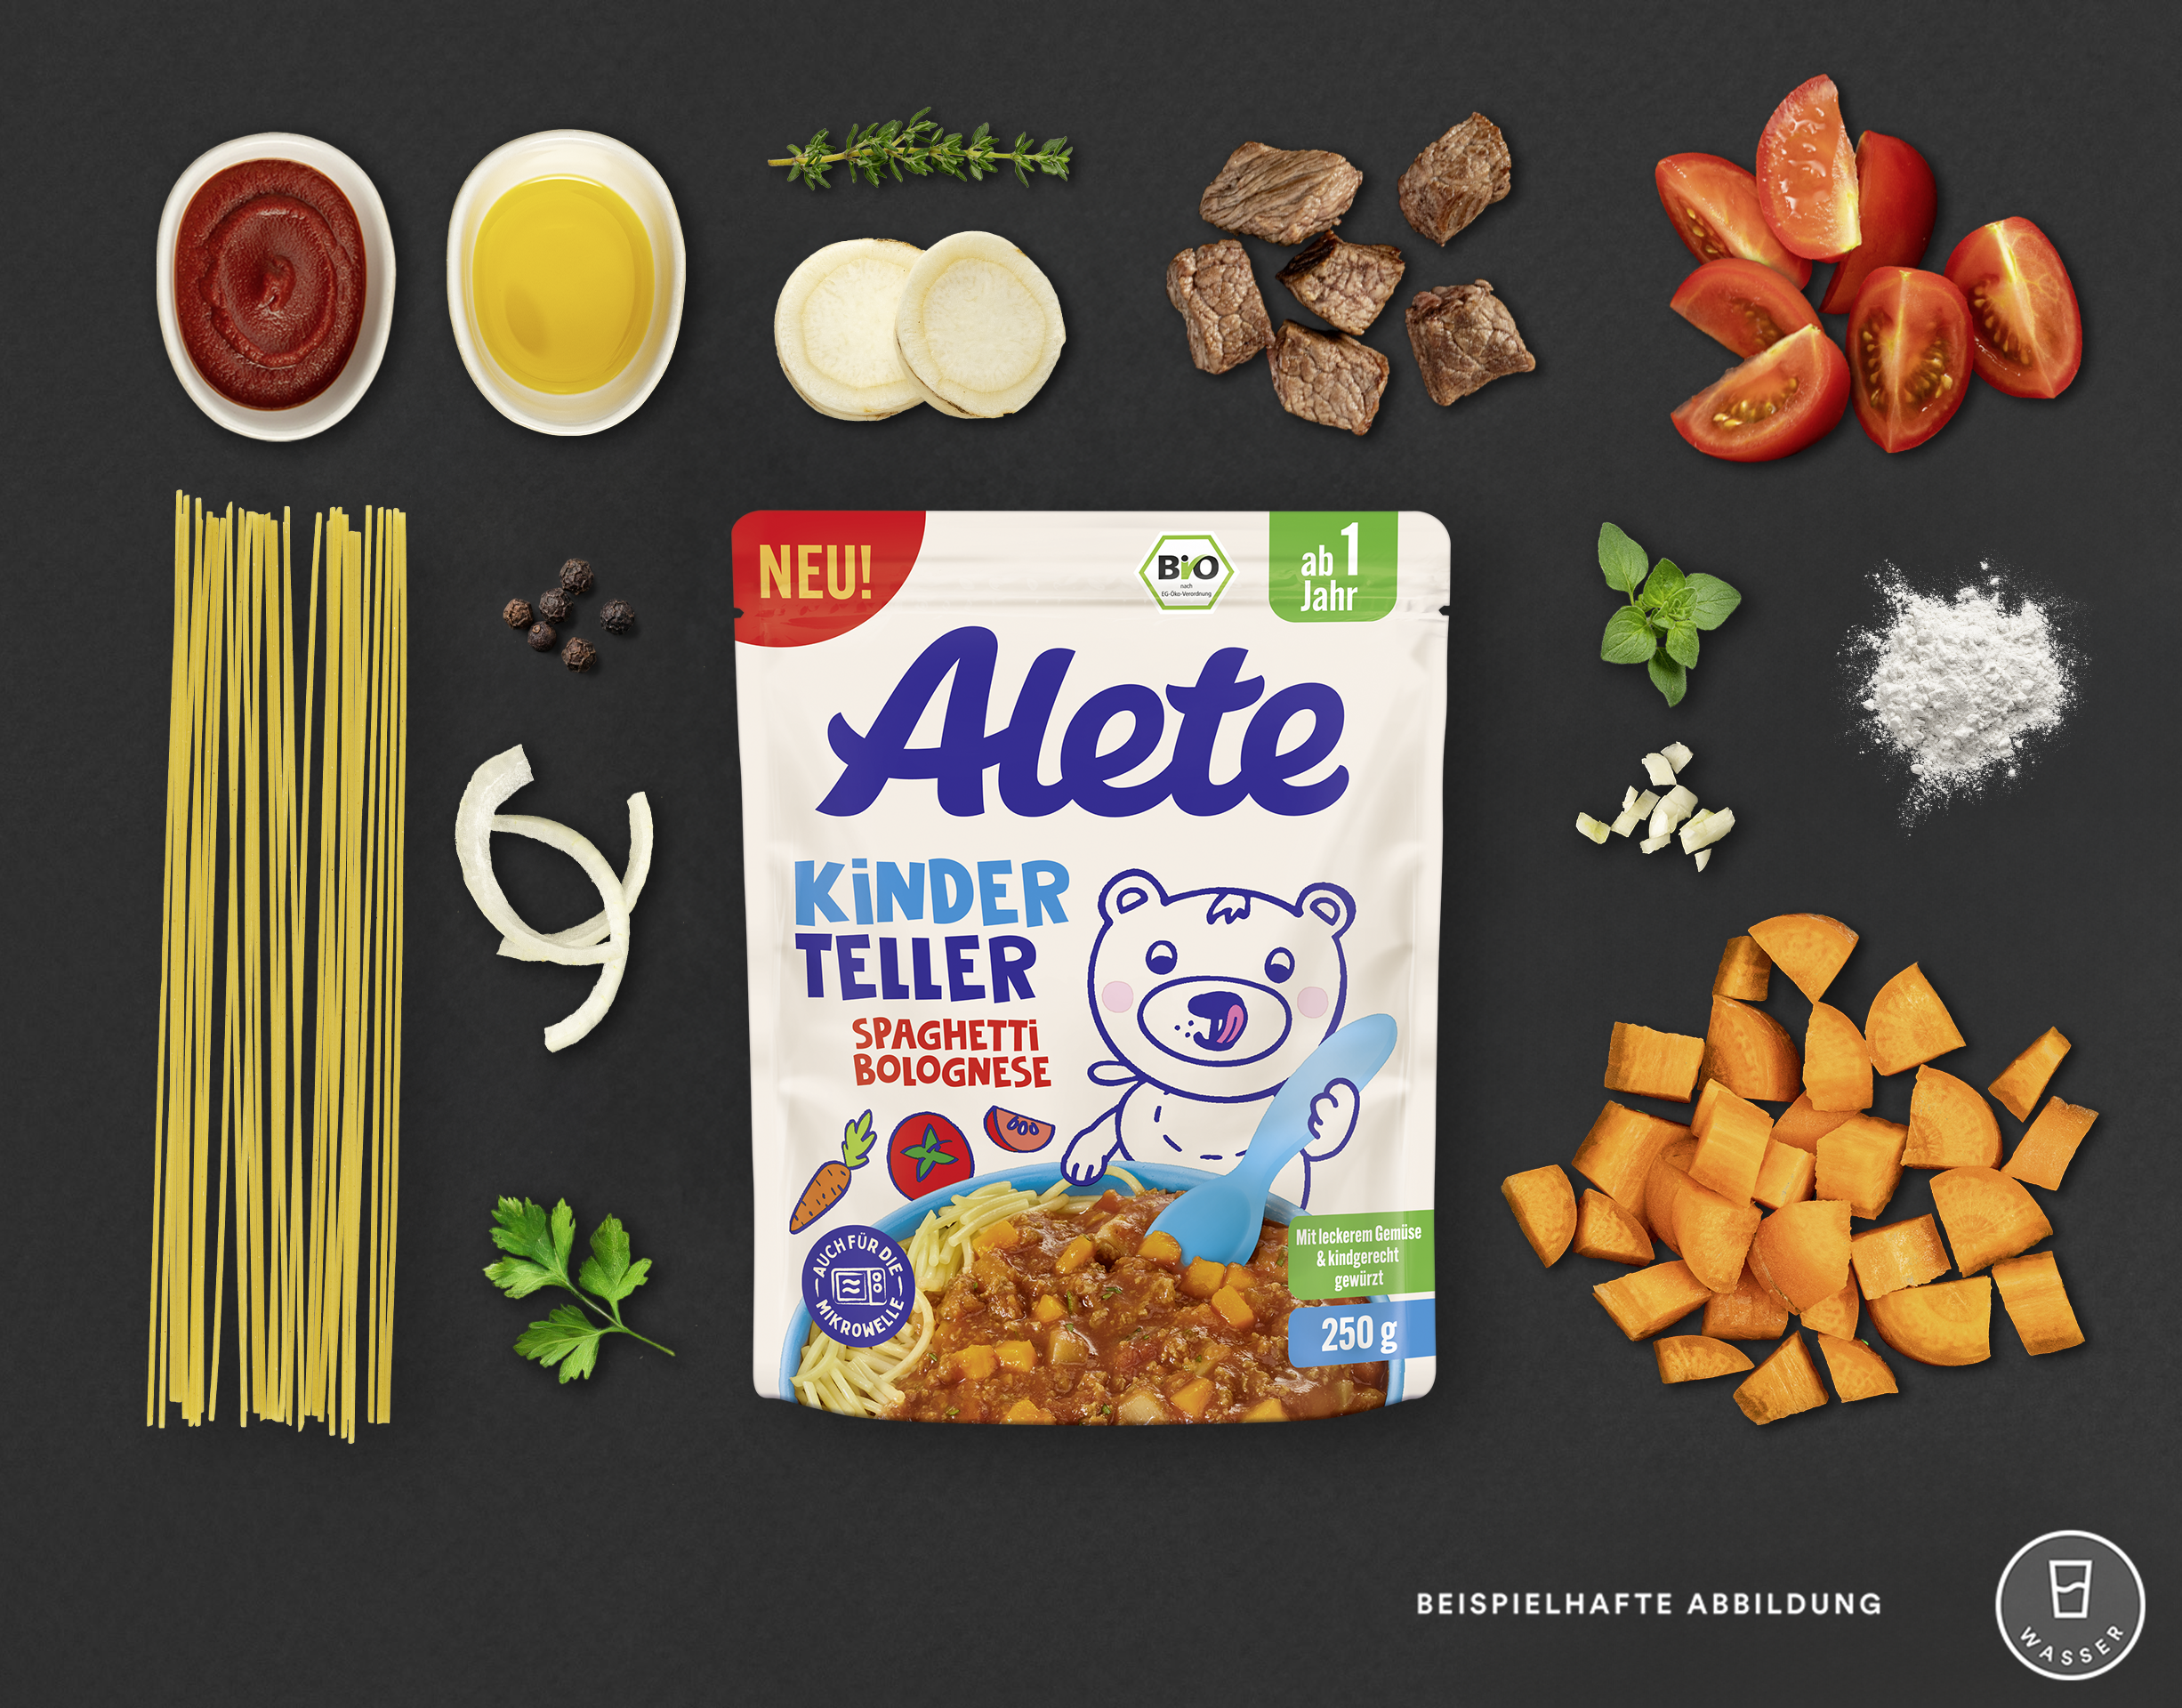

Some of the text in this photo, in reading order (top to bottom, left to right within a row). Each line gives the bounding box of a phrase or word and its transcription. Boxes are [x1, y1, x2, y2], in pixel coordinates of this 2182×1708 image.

[1300, 521, 1359, 576] ab 1
[759, 544, 872, 600] NEU!
[1161, 591, 1212, 599] EG-Öko-Verordnung
[1300, 580, 1358, 612] Jahr
[815, 625, 1349, 818] Alete
[794, 932, 1037, 1003] TELLER
[853, 1053, 1051, 1088] BOLOGNESE
[1296, 1224, 1422, 1245] Mit leckerem Gemüse
[812, 1231, 904, 1278] AUCH FÜR DIE
[1316, 1247, 1399, 1269] & kindgerecht
[1334, 1270, 1384, 1292] gewürzt
[815, 1296, 905, 1338] MIKROWELLE
[1321, 1315, 1398, 1354] 250 g
